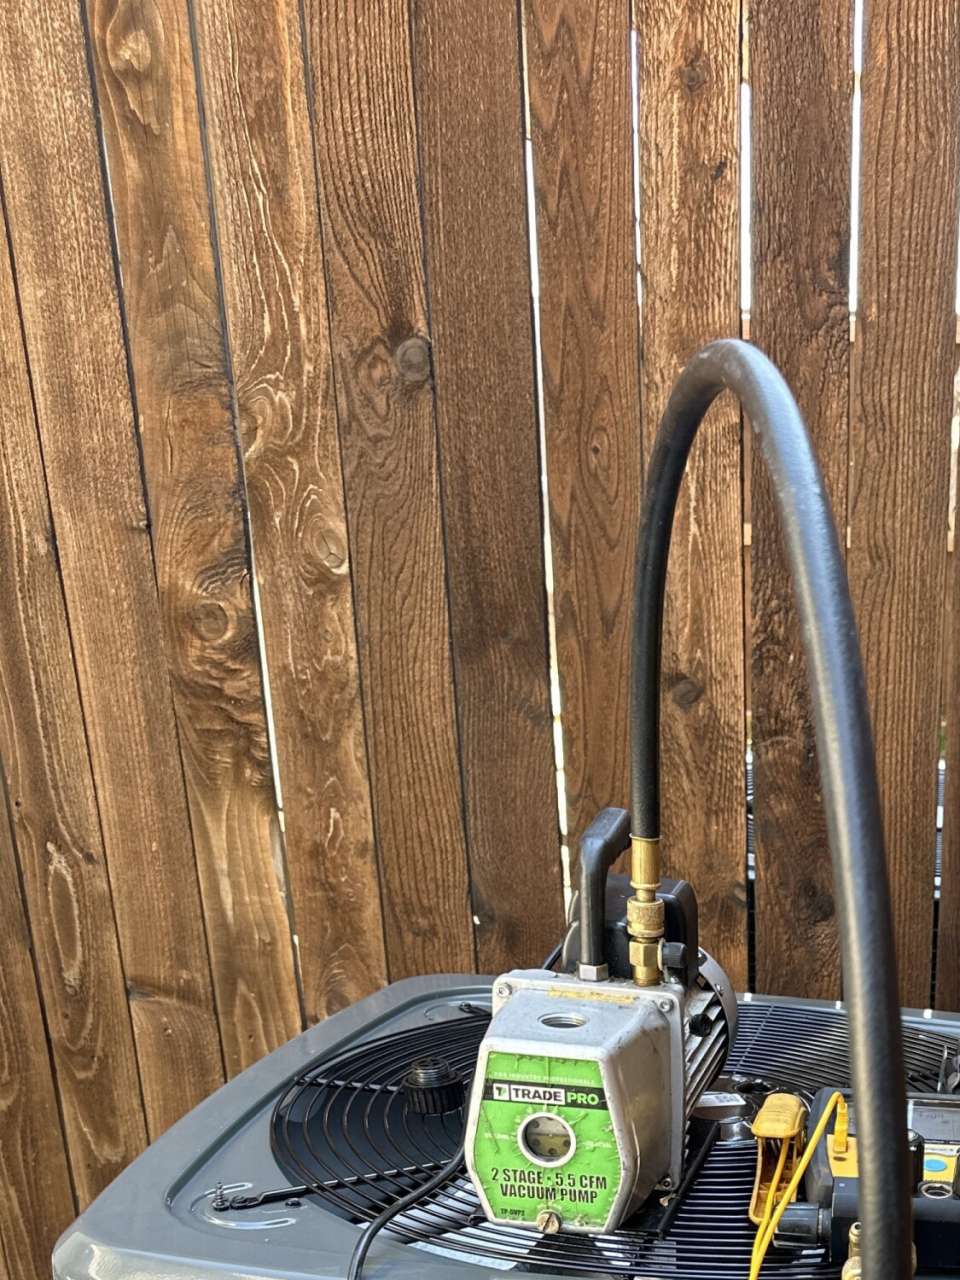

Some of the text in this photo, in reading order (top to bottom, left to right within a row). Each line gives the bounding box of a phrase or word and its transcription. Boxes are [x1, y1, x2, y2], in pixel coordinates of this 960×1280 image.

[512, 1087, 563, 1102] TRADE
[566, 1092, 600, 1105] PRO
[491, 1167, 607, 1190] 2 STAGE 5.5 CFM
[500, 1183, 598, 1204] VACUUM PUMP
